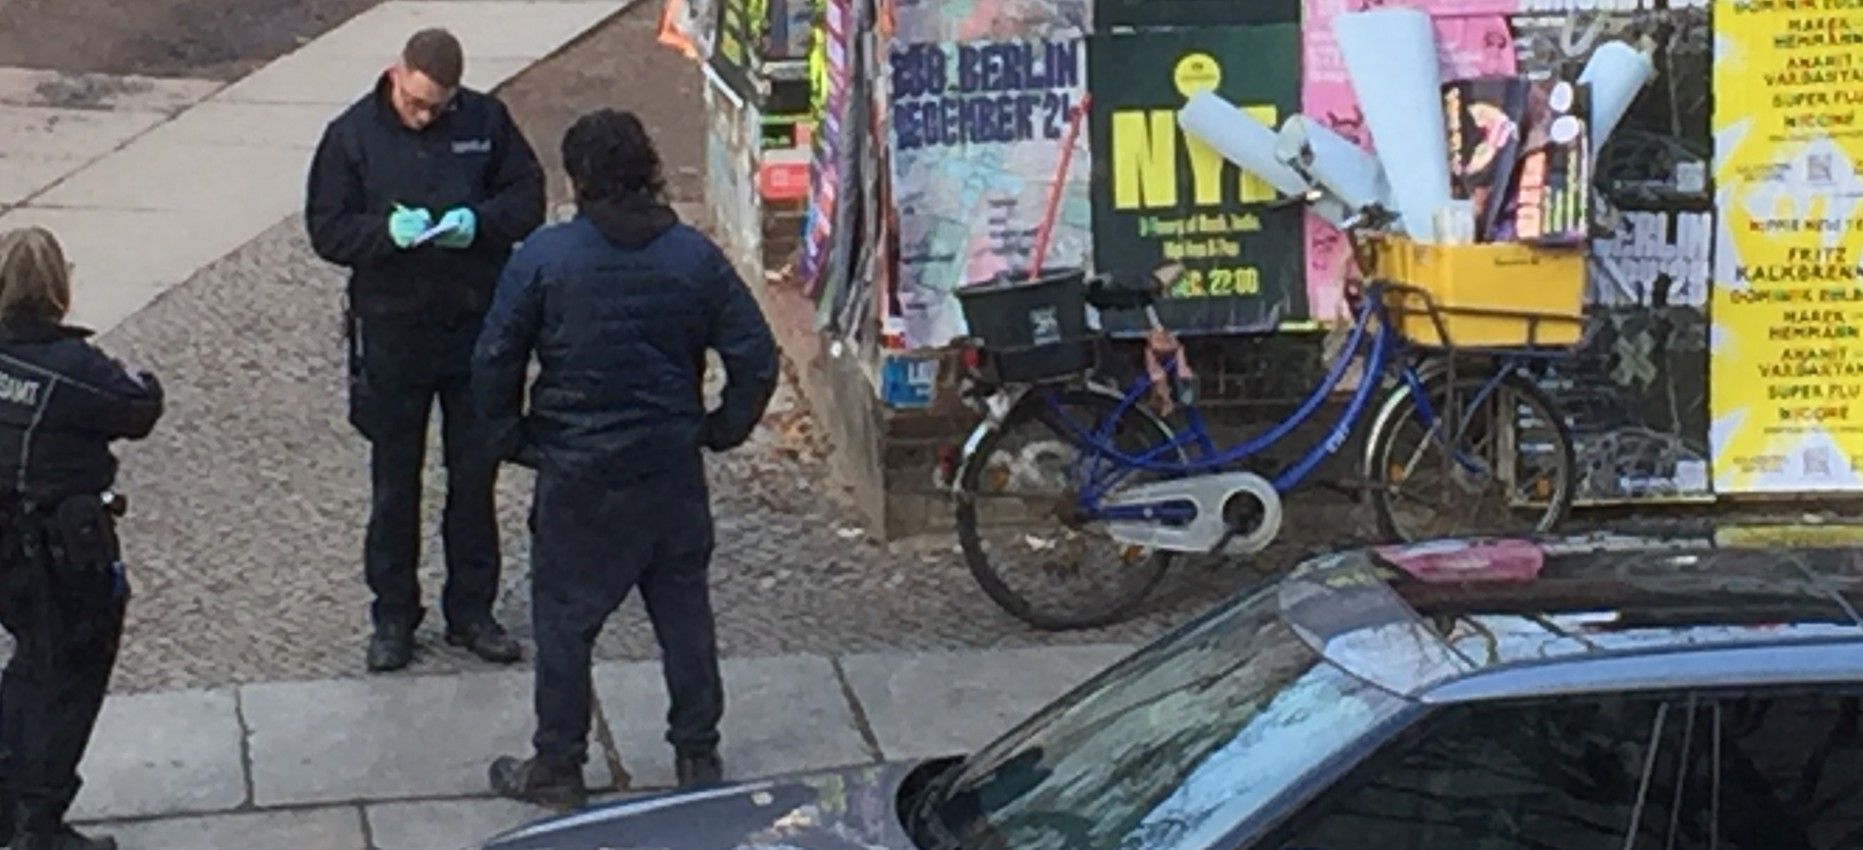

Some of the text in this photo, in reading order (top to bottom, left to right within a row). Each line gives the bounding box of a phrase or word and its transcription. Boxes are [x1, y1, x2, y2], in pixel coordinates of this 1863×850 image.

[1788, 18, 1851, 32] MAREK
[957, 38, 1079, 92] BERLIN
[1789, 246, 1847, 262] FRITZ
[1784, 309, 1846, 324] MAREK
[1768, 325, 1861, 340] HEMMANN
[1768, 385, 1861, 401] SUPER FLU
